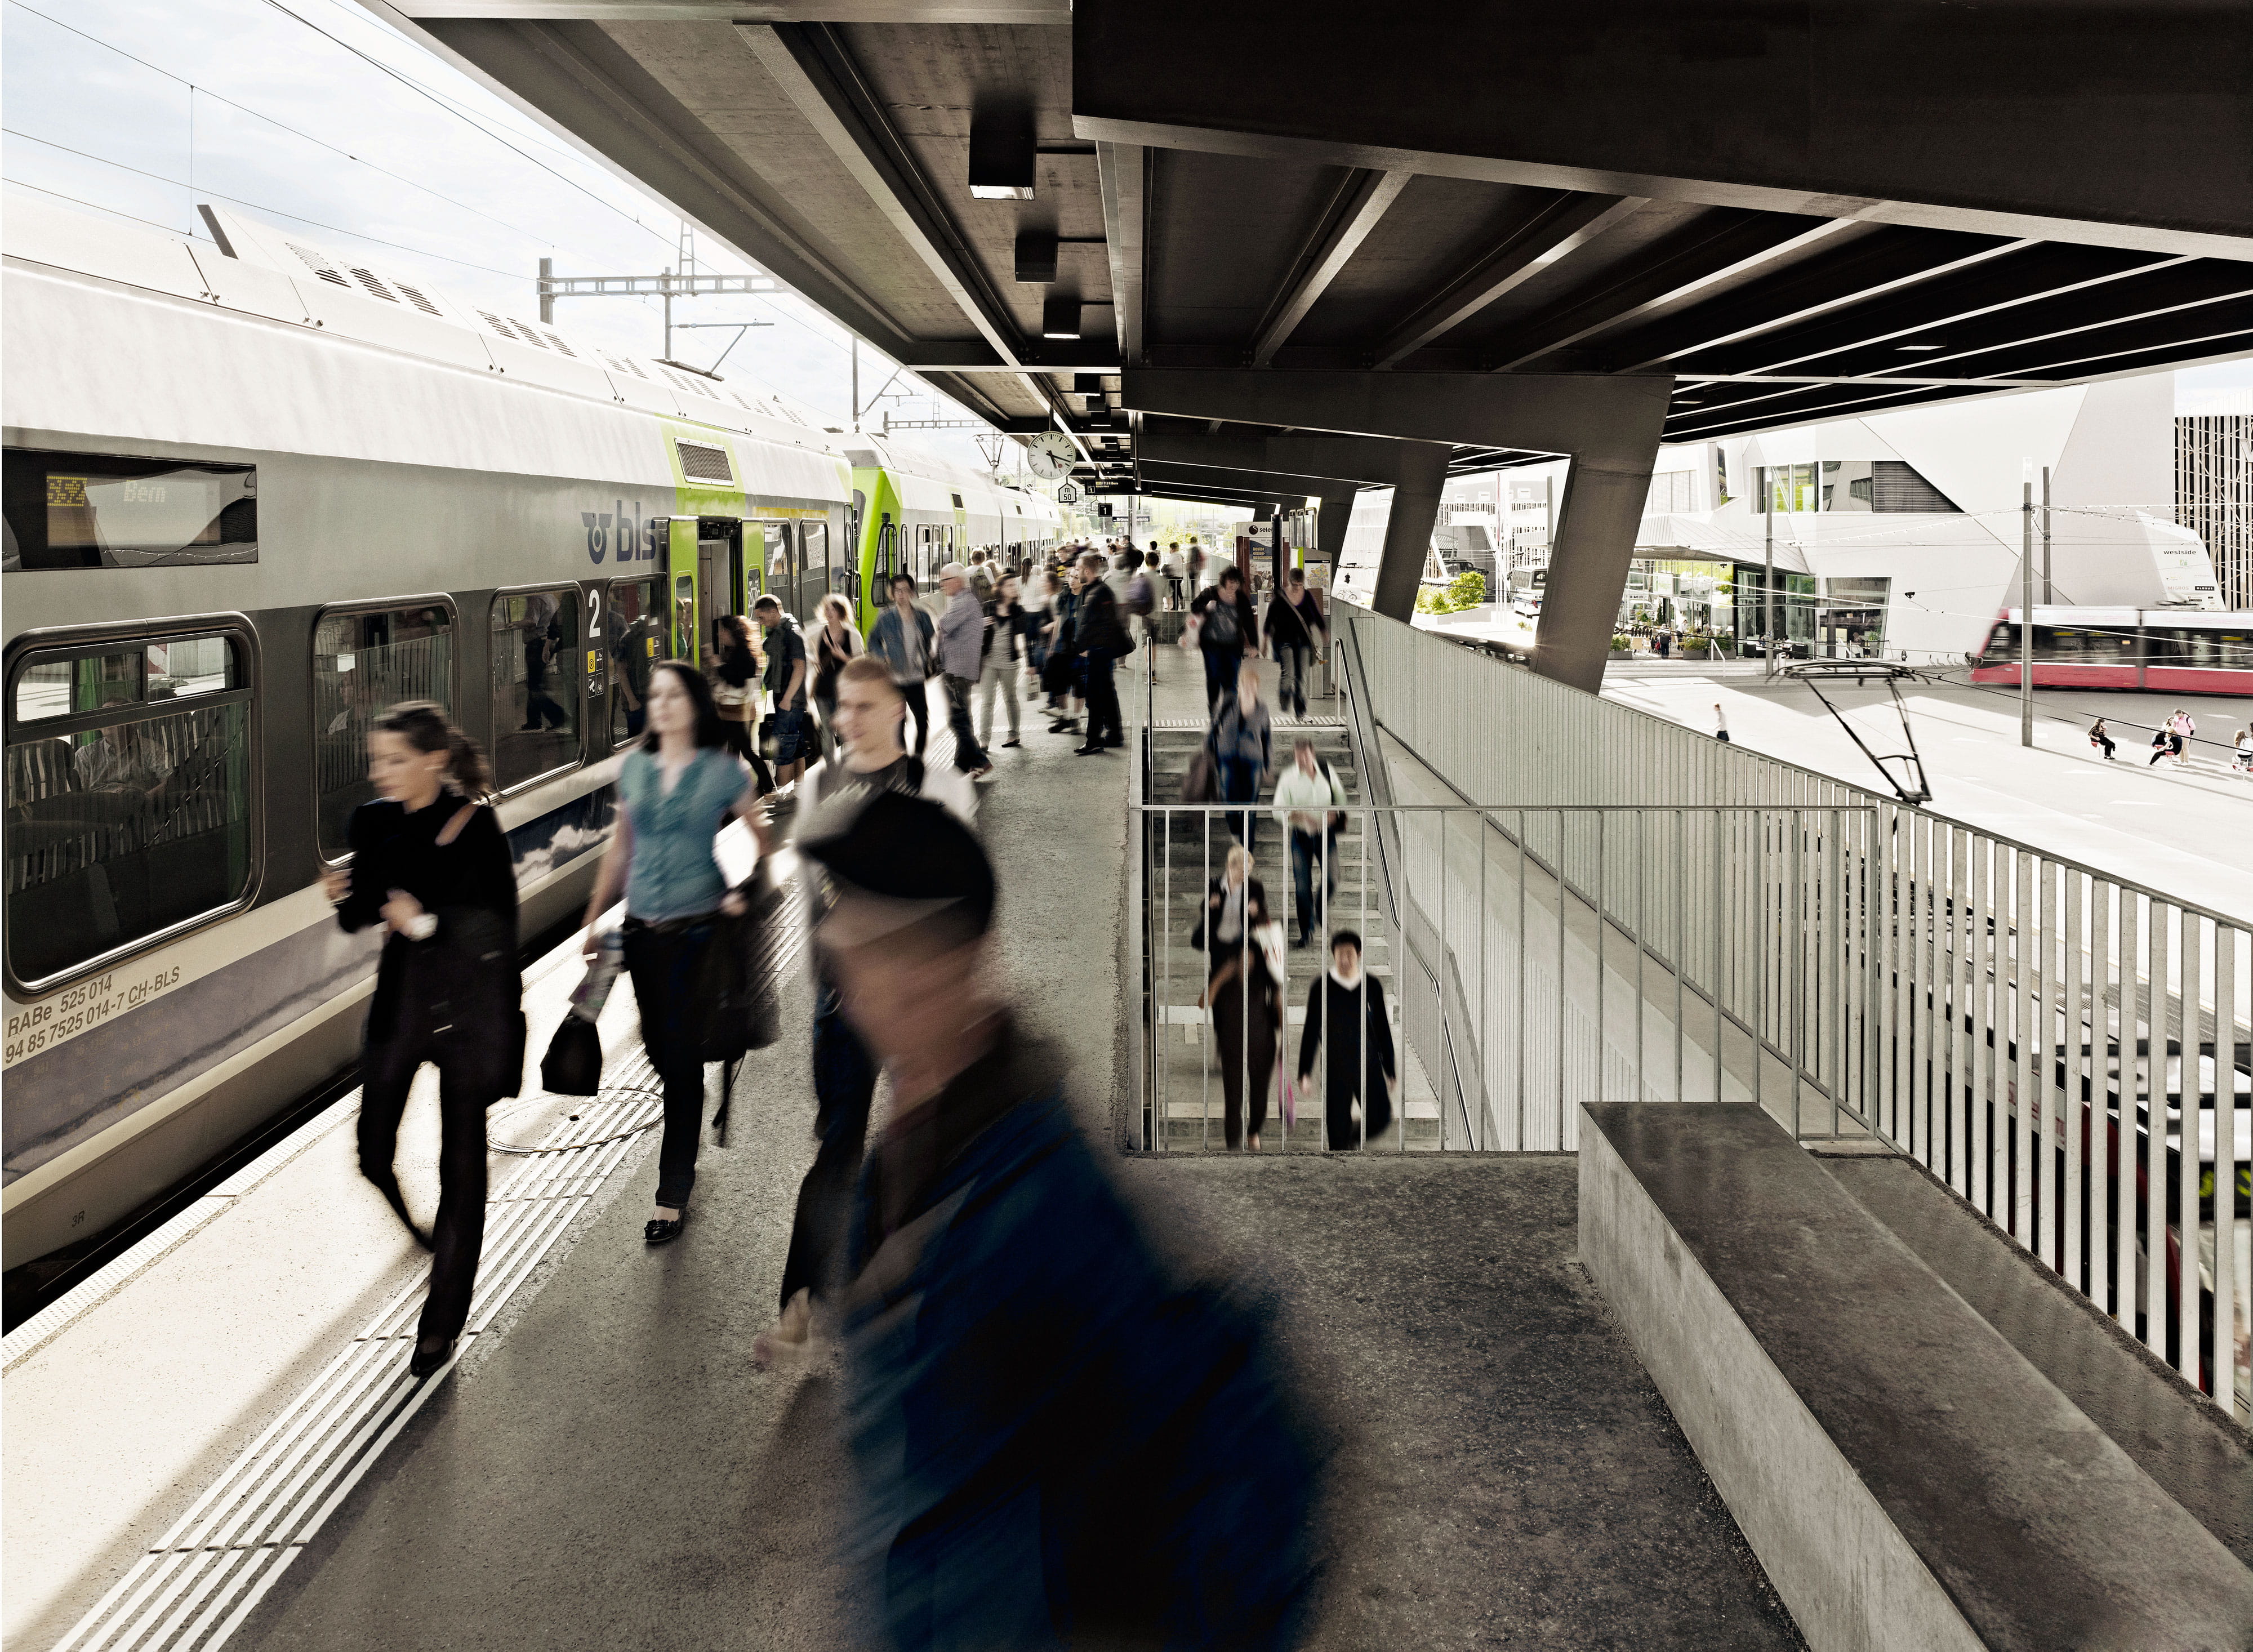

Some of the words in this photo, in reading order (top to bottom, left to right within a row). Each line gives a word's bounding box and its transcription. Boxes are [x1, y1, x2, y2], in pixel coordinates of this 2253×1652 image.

[124, 480, 166, 502] Bern
[616, 500, 656, 562] bls
[589, 589, 600, 638] 2
[6, 1039, 24, 1063] 94
[28, 1029, 46, 1053] 85
[50, 1012, 83, 1043] 7525
[127, 966, 180, 1009] CH-BLS
[8, 1006, 52, 1037] RABe
[60, 986, 86, 1013] 525
[89, 974, 112, 1000] 014
